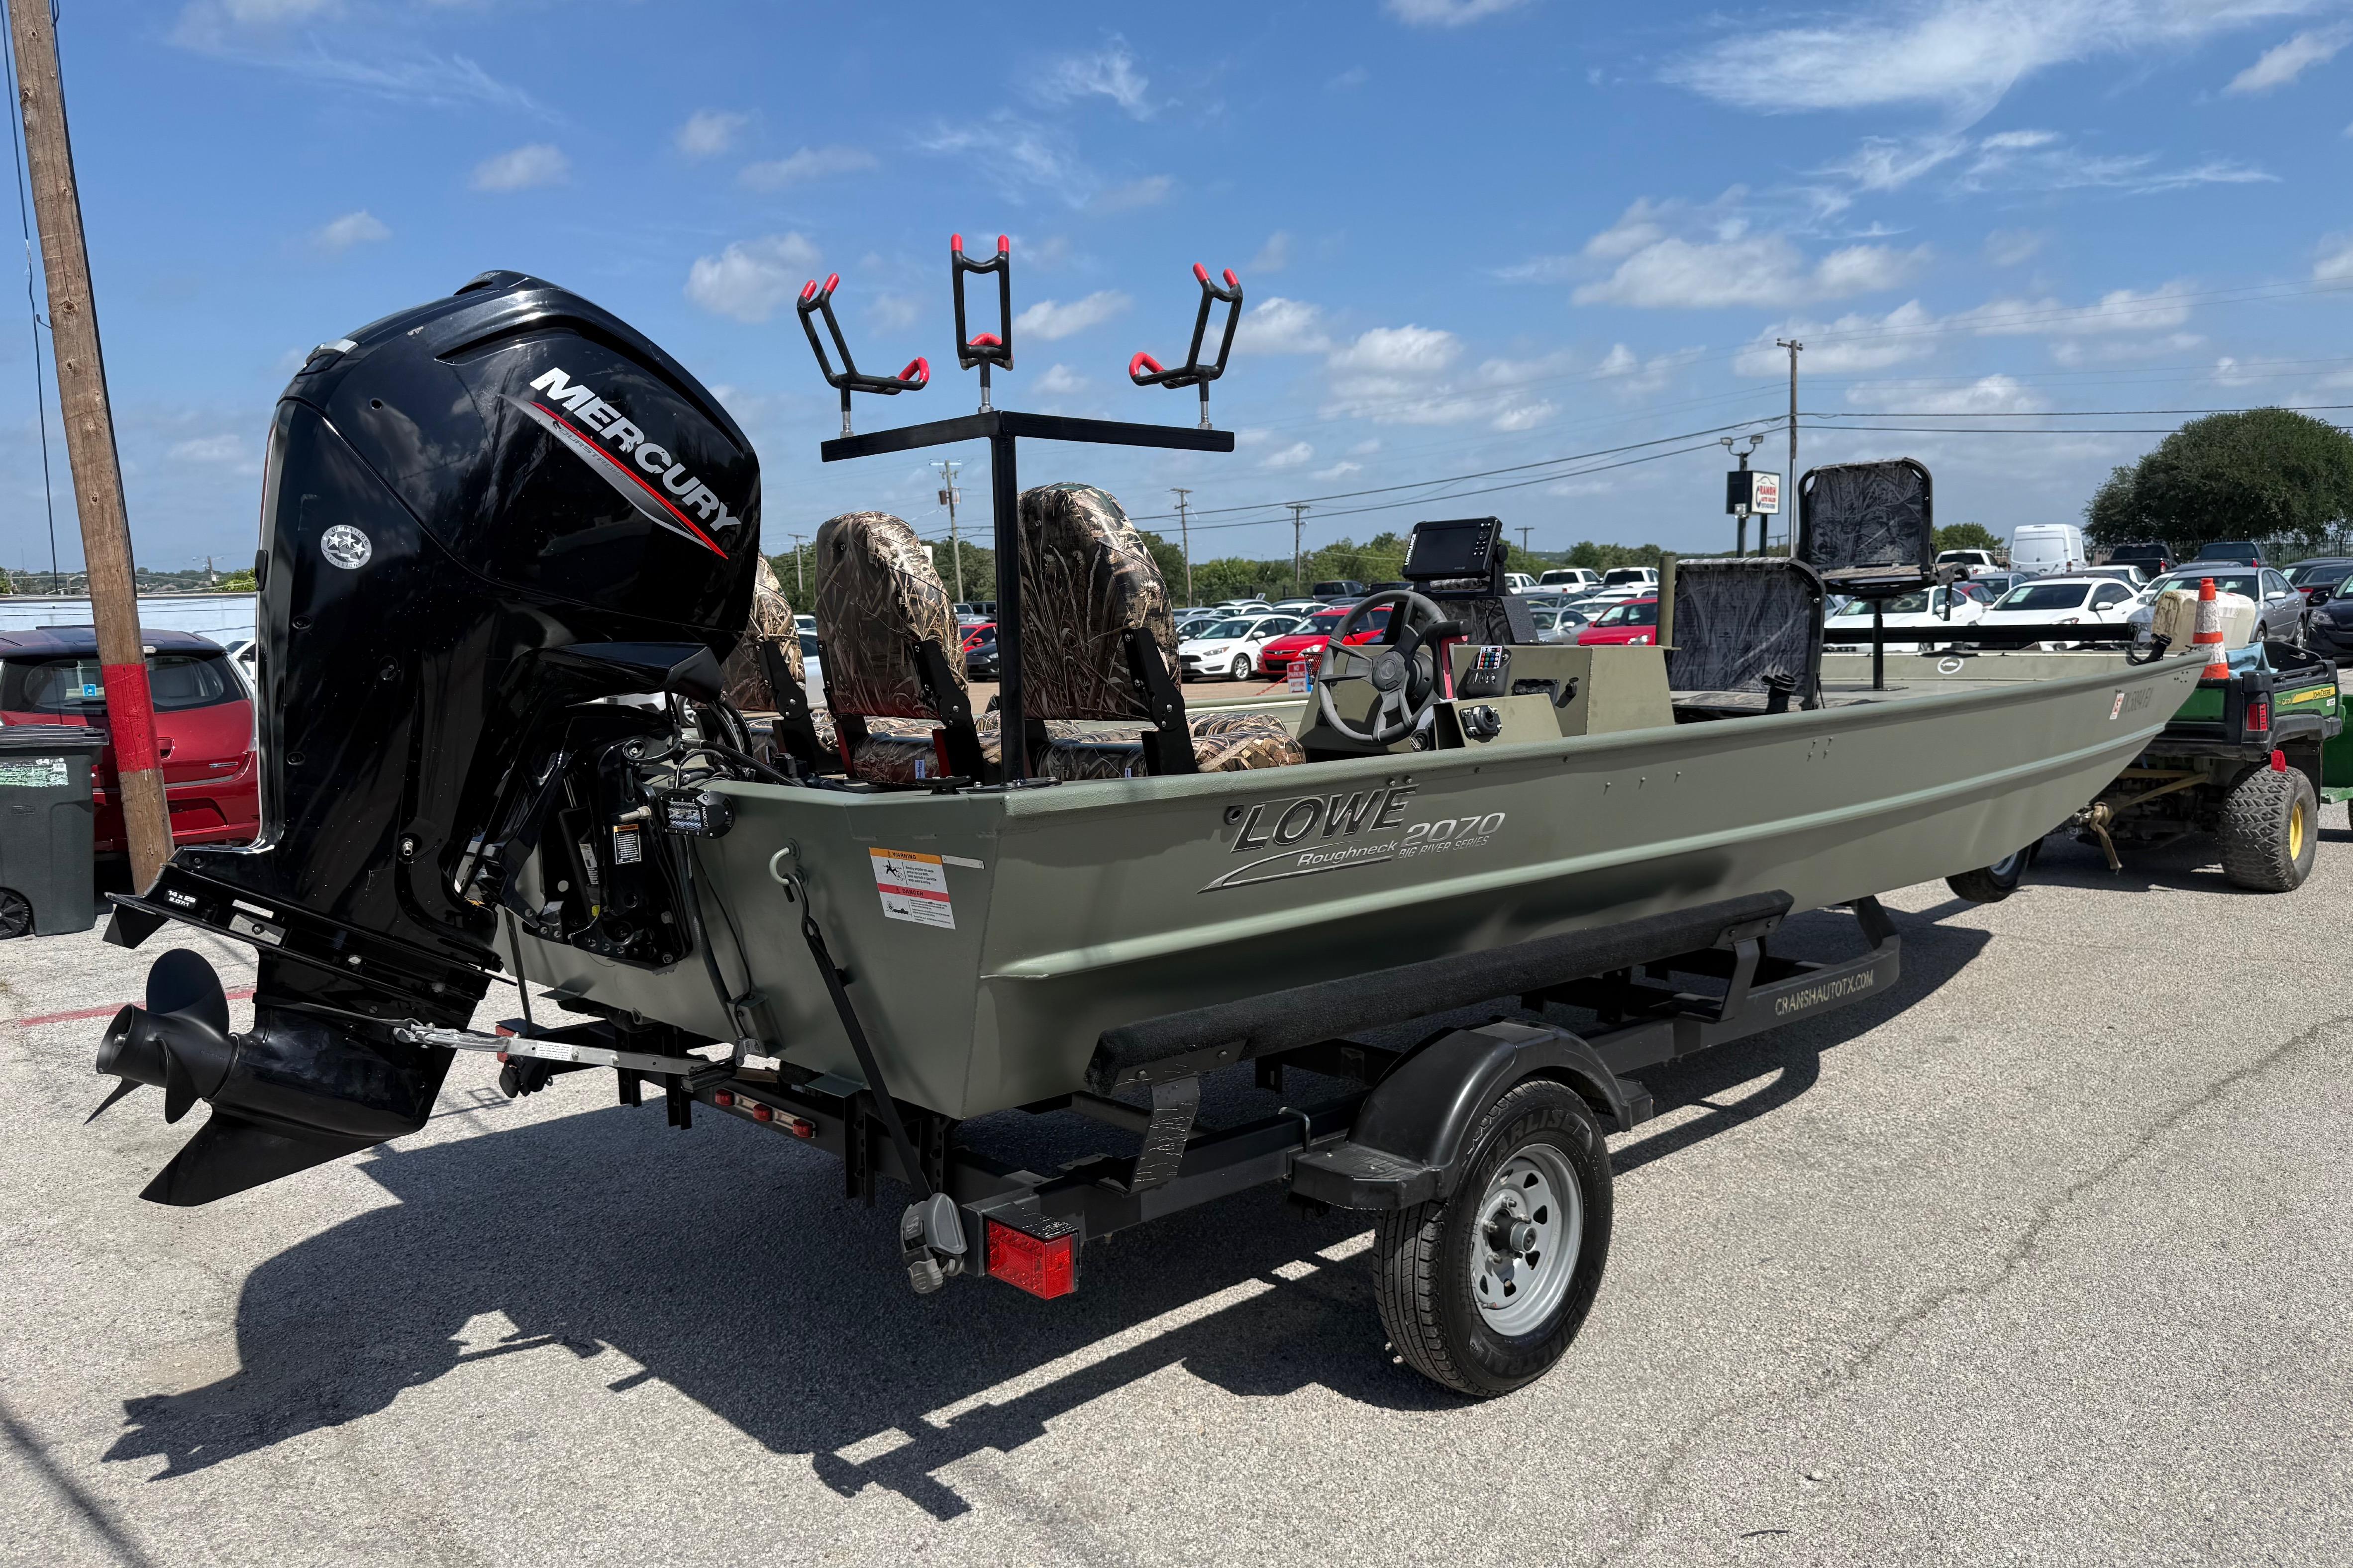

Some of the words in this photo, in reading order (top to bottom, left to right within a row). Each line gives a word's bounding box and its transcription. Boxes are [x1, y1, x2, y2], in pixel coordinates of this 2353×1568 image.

[529, 367, 741, 531] MERCURY
[1404, 533, 1417, 566] LOWRANCE
[1230, 784, 1420, 854] LOWE
[1401, 812, 1505, 847] 2070
[1297, 840, 1399, 867] Roughneck
[1398, 847, 1416, 860] BIG
[1420, 843, 1451, 856] RIVER
[1452, 836, 1490, 851] SERIES
[1775, 969, 1874, 1016] CRANSHAUTOTX.COM
